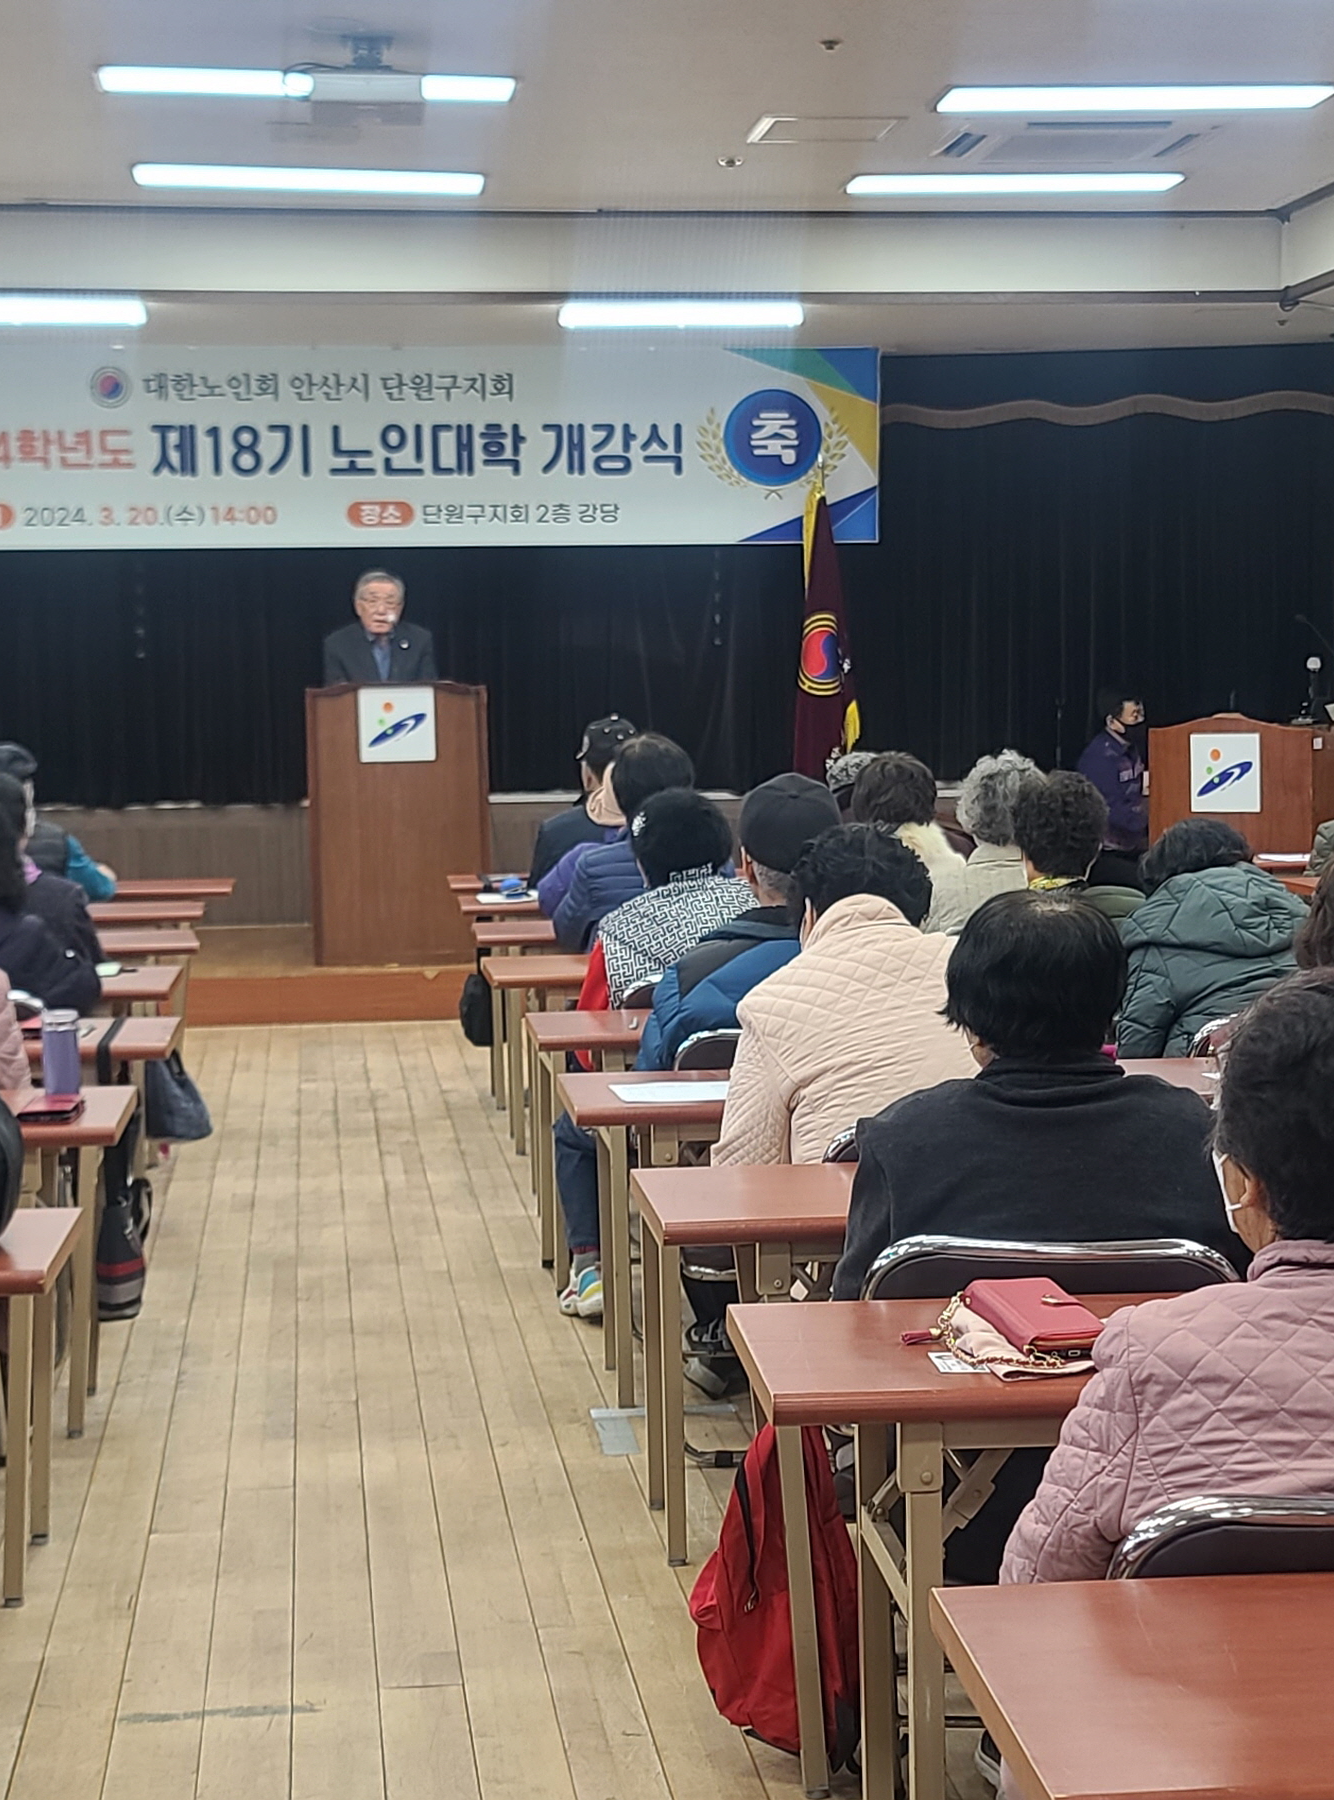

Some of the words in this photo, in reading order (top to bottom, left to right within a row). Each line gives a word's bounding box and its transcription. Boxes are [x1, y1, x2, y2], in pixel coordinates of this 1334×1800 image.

[142, 372, 279, 402] 대한노인회
[290, 372, 371, 402] 안산시
[380, 372, 515, 401] 단원구지회
[151, 423, 311, 478] 제18기
[328, 422, 527, 477] 노인대학
[540, 421, 684, 477] 개강식
[749, 410, 800, 467] 축
[359, 503, 403, 526] 장소
[421, 502, 530, 525] 단원구지회
[535, 502, 571, 524] 2층
[577, 503, 620, 525] 강당
